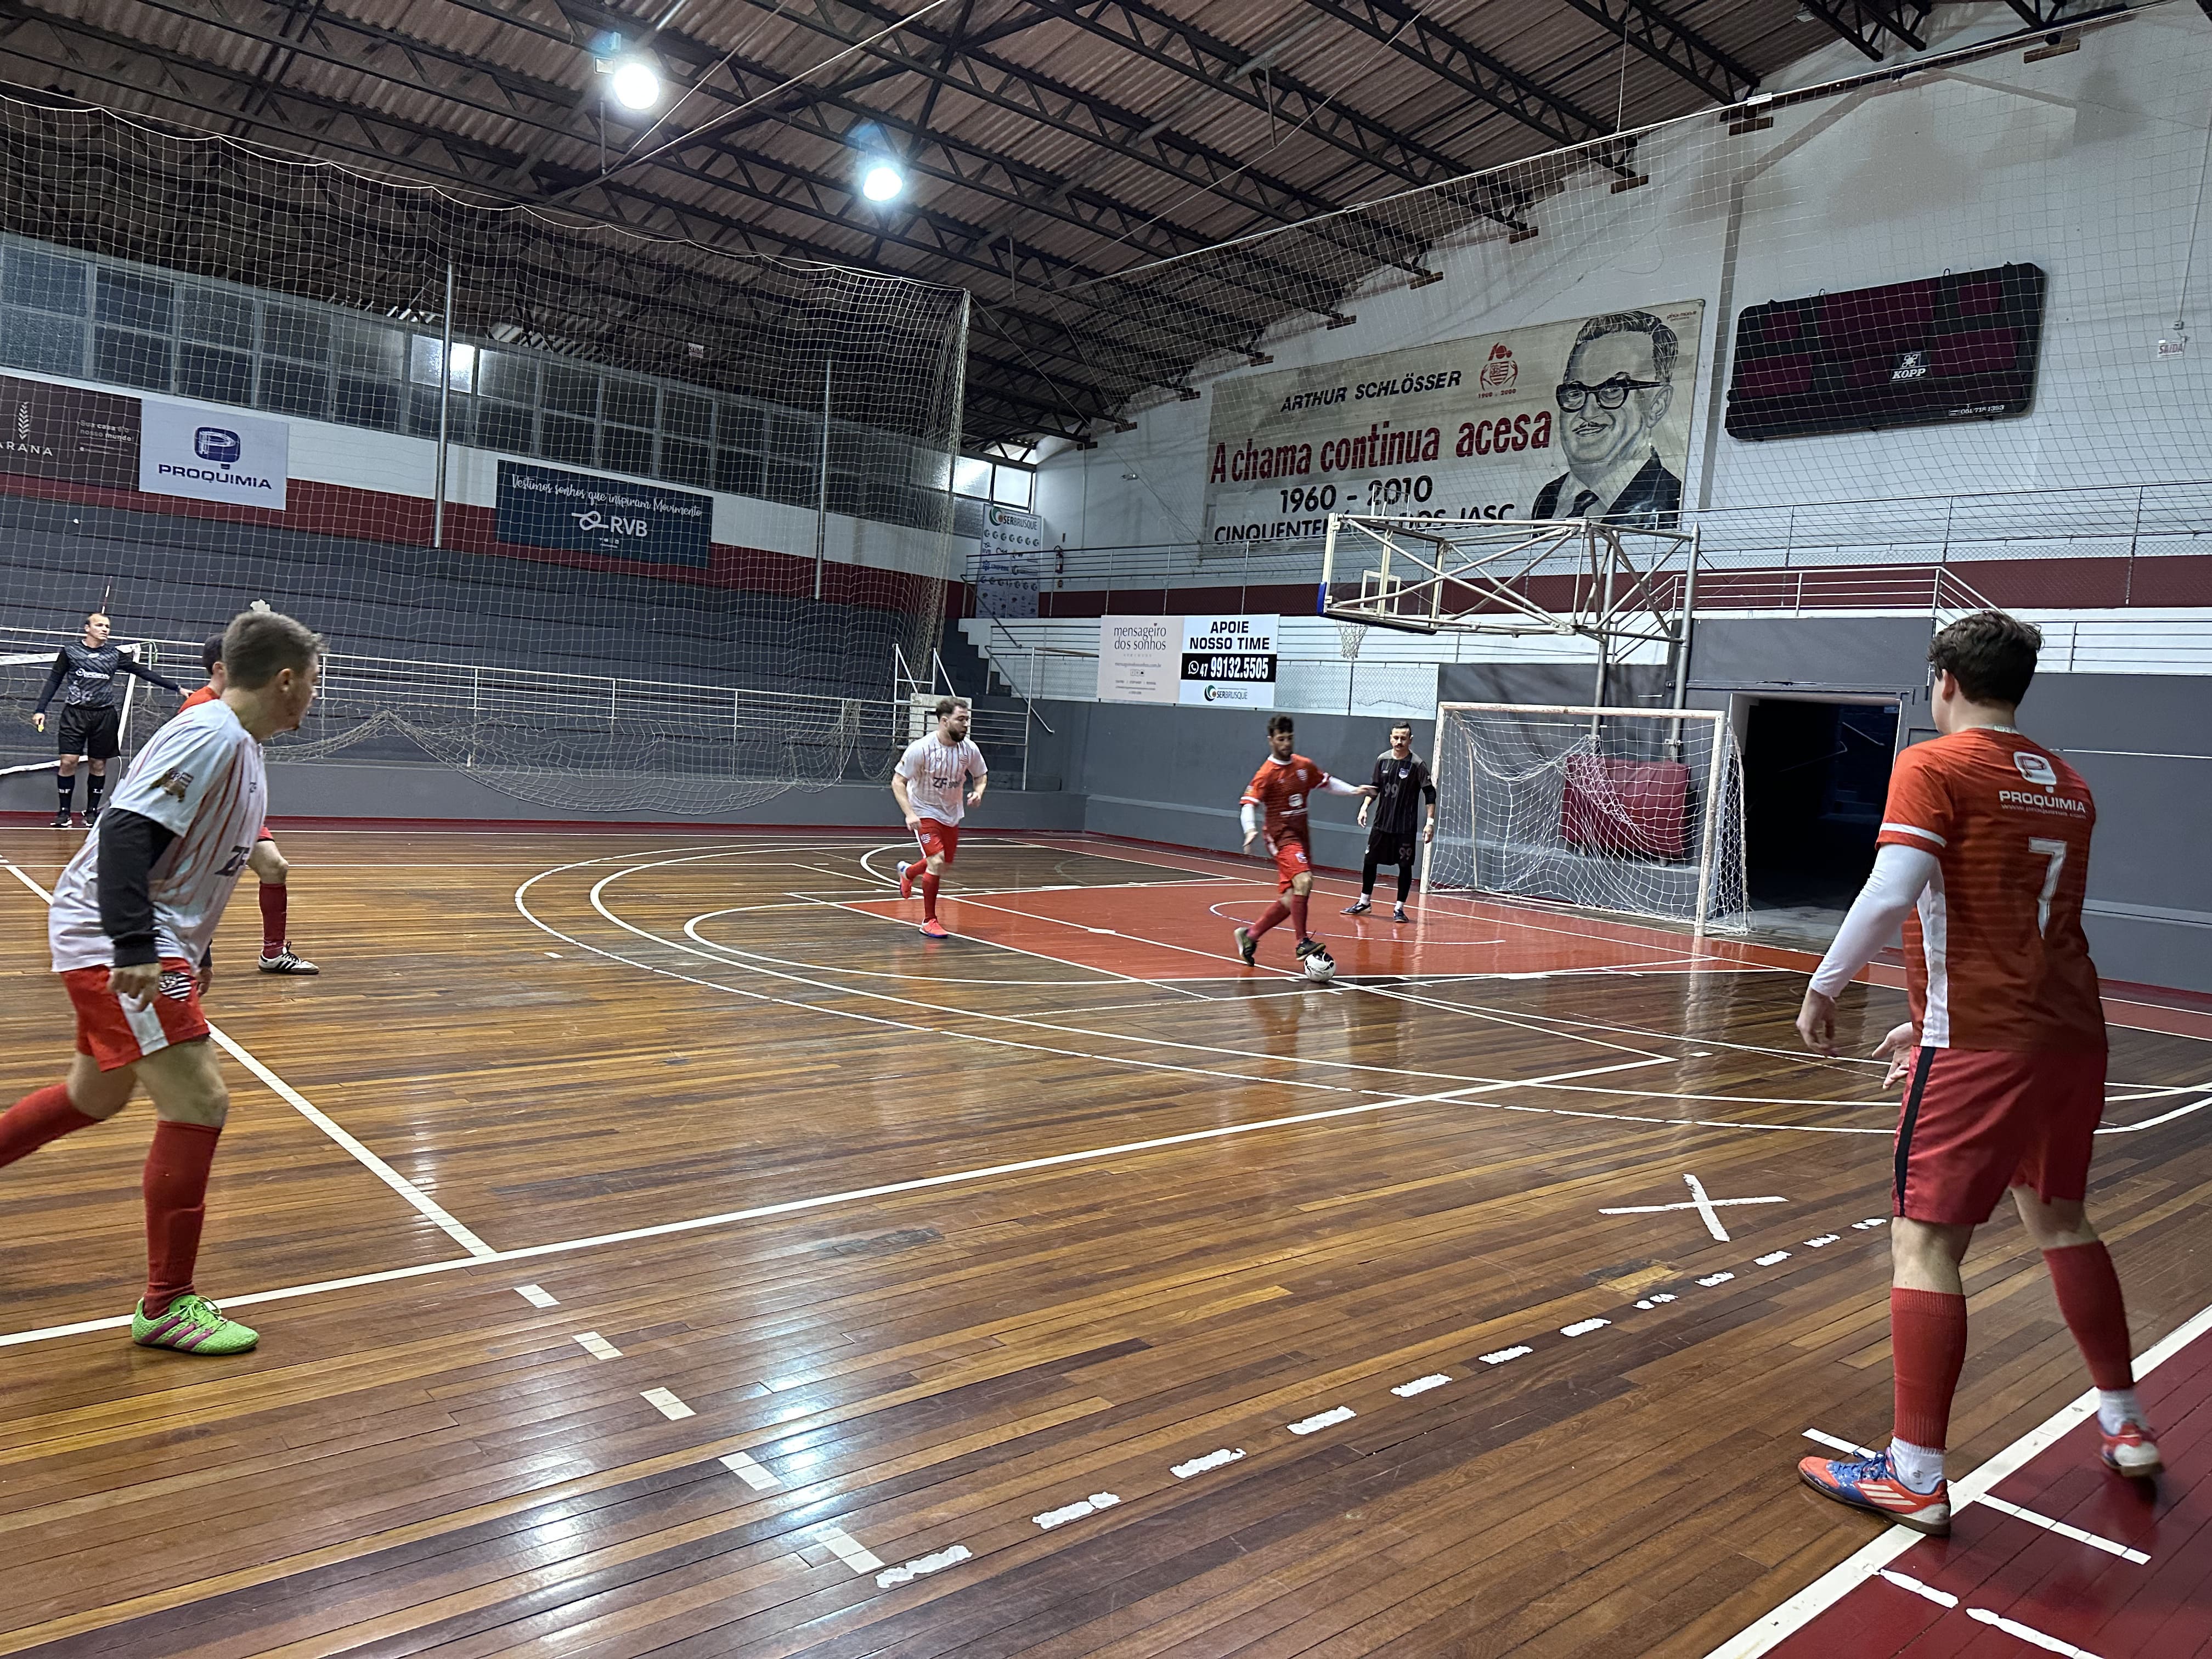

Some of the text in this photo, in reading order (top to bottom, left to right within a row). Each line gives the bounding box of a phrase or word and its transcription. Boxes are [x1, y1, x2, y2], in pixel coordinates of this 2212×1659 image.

[1892, 368, 1926, 379] KOPP
[1280, 370, 1462, 412] ARTHUR SCHLÖSSER
[1210, 411, 1552, 484] A chama continua acesa
[159, 464, 273, 489] PROQUIMIA
[511, 473, 703, 518] Vestimos sonhos que inspiram Movimento
[1280, 484, 1337, 514] 1960
[1367, 475, 1433, 506] 2010
[610, 516, 648, 537] RVB
[1003, 515, 1038, 531] SERBRUSQUE
[1114, 623, 1167, 641] mensageiro
[1210, 621, 1249, 634] APOIE
[1114, 635, 1166, 650] dos sonhos
[1189, 637, 1270, 650] NOSSO TIME
[1200, 656, 1269, 679] 47 99132.5505
[1216, 691, 1248, 700] SERBRUSQUE
[1385, 783, 1398, 799] 99
[1999, 790, 2086, 814] PROQUIMIA
[1399, 847, 1413, 860] 99
[2028, 836, 2067, 940] 7
